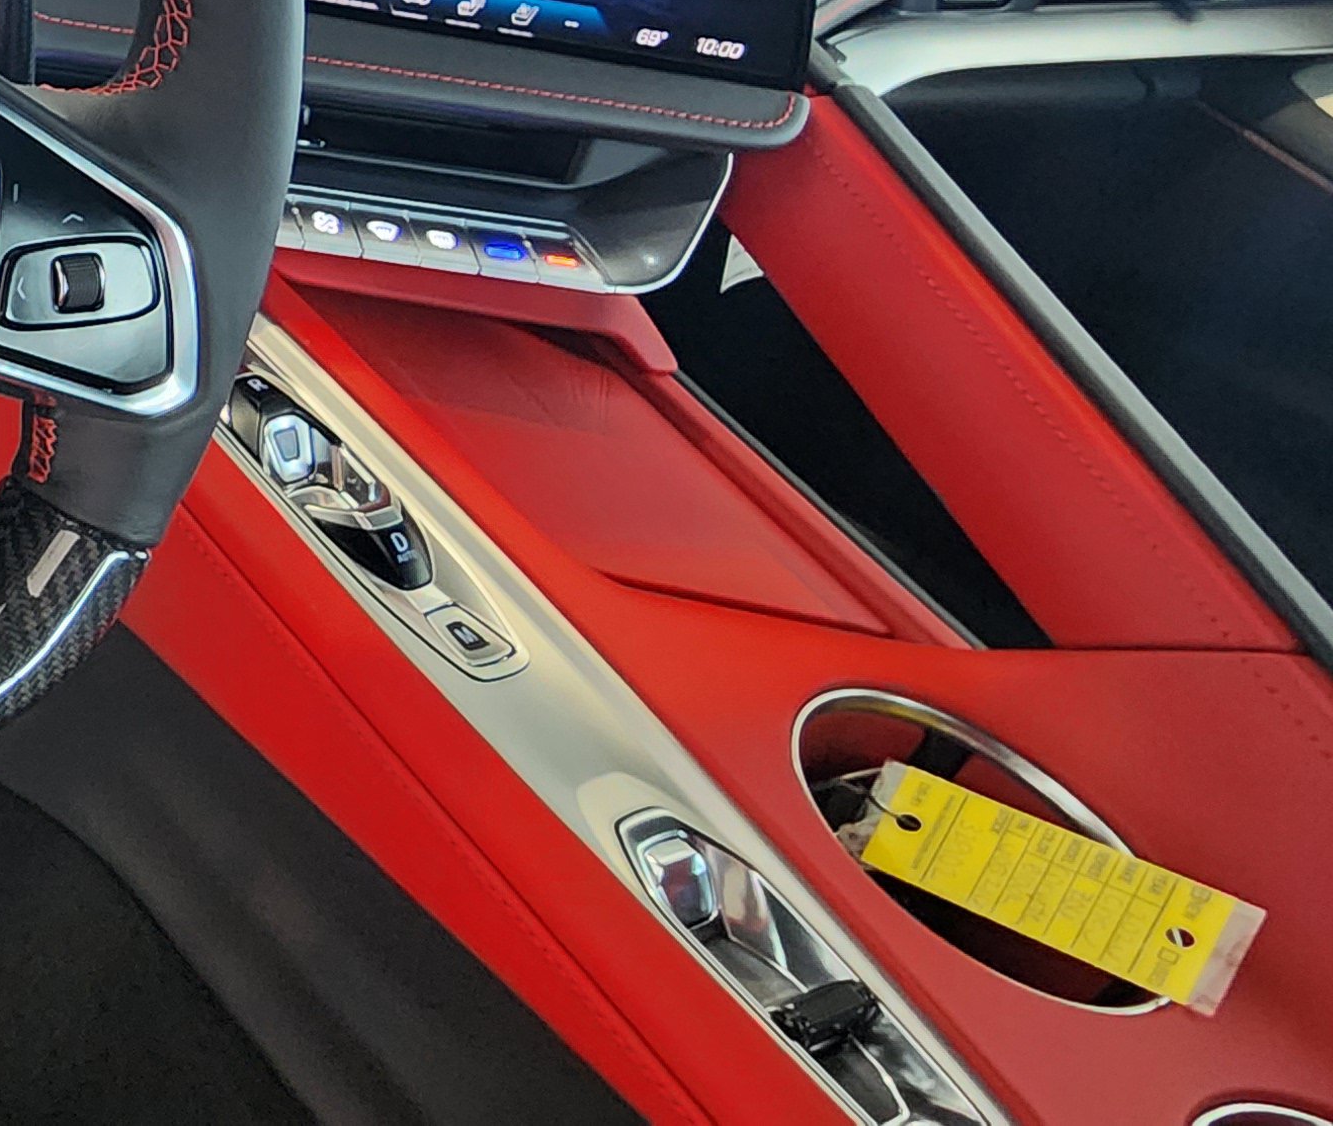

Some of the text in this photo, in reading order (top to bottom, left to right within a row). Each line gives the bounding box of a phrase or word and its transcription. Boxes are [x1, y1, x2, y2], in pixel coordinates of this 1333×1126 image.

[695, 35, 745, 60] 10:00
[247, 377, 269, 392] R
[390, 532, 408, 553] D
[454, 627, 477, 644] M
